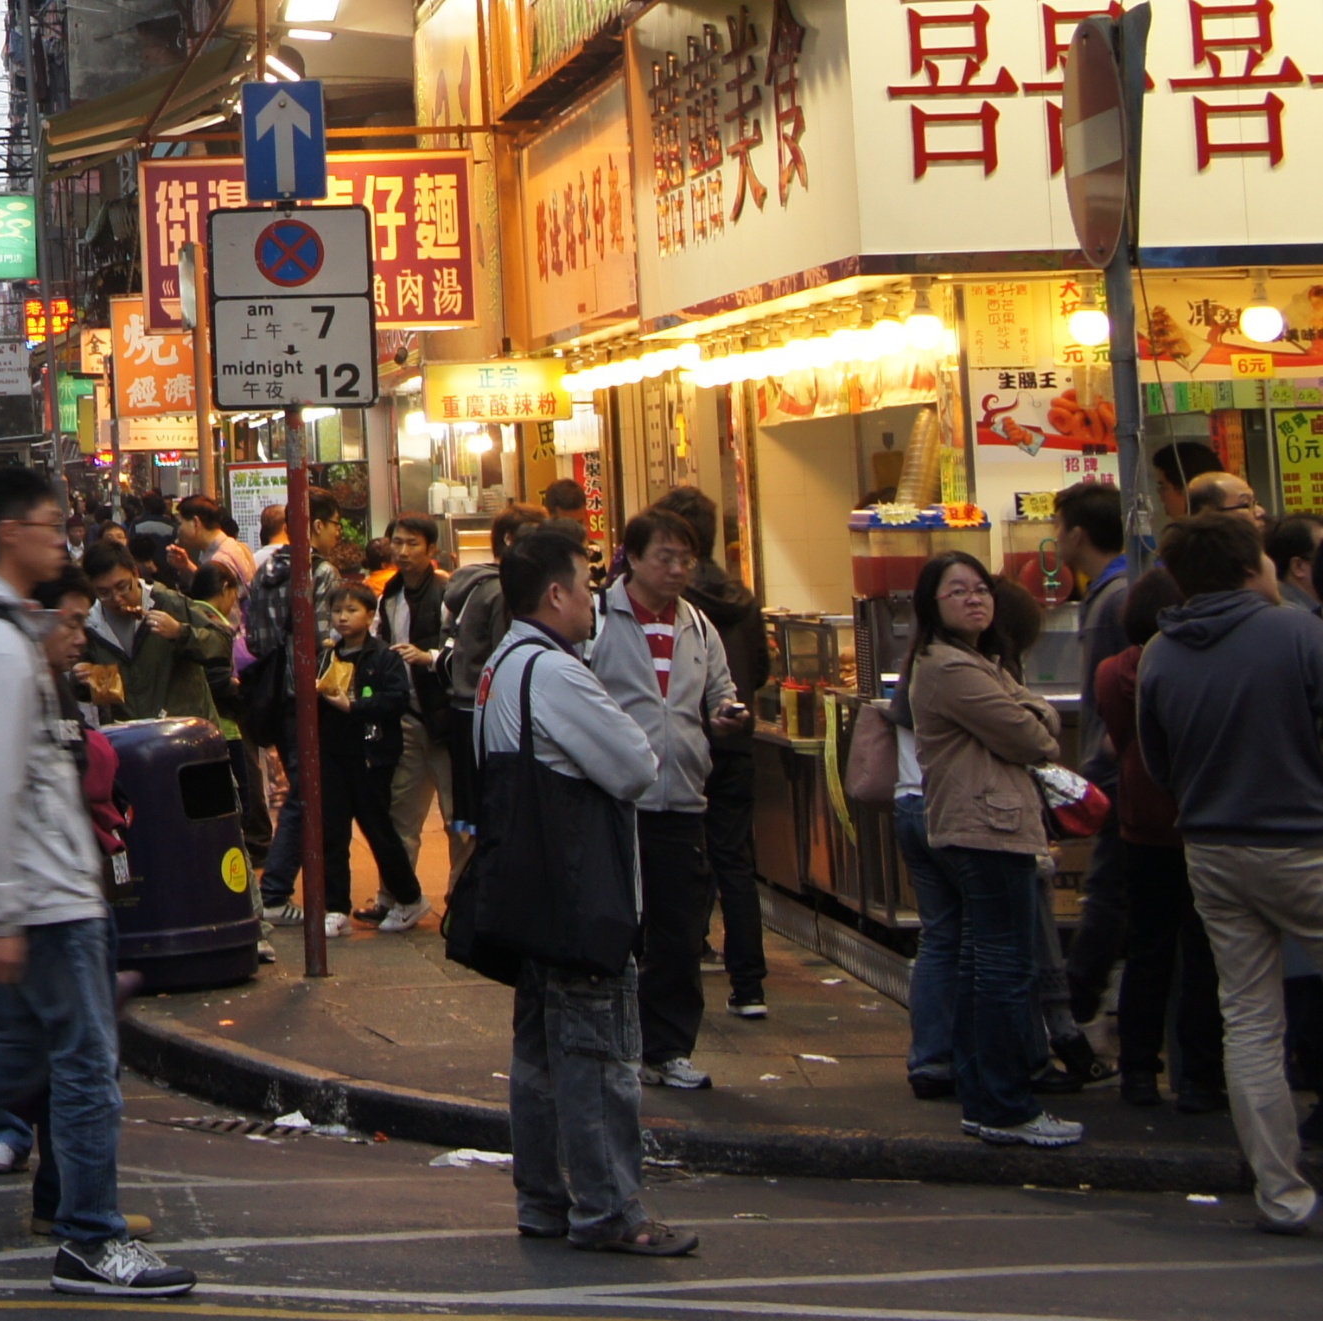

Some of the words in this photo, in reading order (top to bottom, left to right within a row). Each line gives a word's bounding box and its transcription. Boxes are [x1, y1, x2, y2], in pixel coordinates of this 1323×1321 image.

[241, 322, 283, 341] 上午
[246, 304, 275, 318] am
[311, 305, 336, 340] 7
[1237, 357, 1267, 374] 6元
[222, 359, 304, 378] midnight
[314, 363, 361, 398] 12
[478, 365, 519, 389] 正宗
[998, 371, 1058, 389] 生腸王
[242, 380, 285, 400] 午夜
[441, 391, 557, 419] 重慶酸辣粉
[1286, 434, 1321, 464] 6元
[1065, 457, 1099, 473] 招牌
